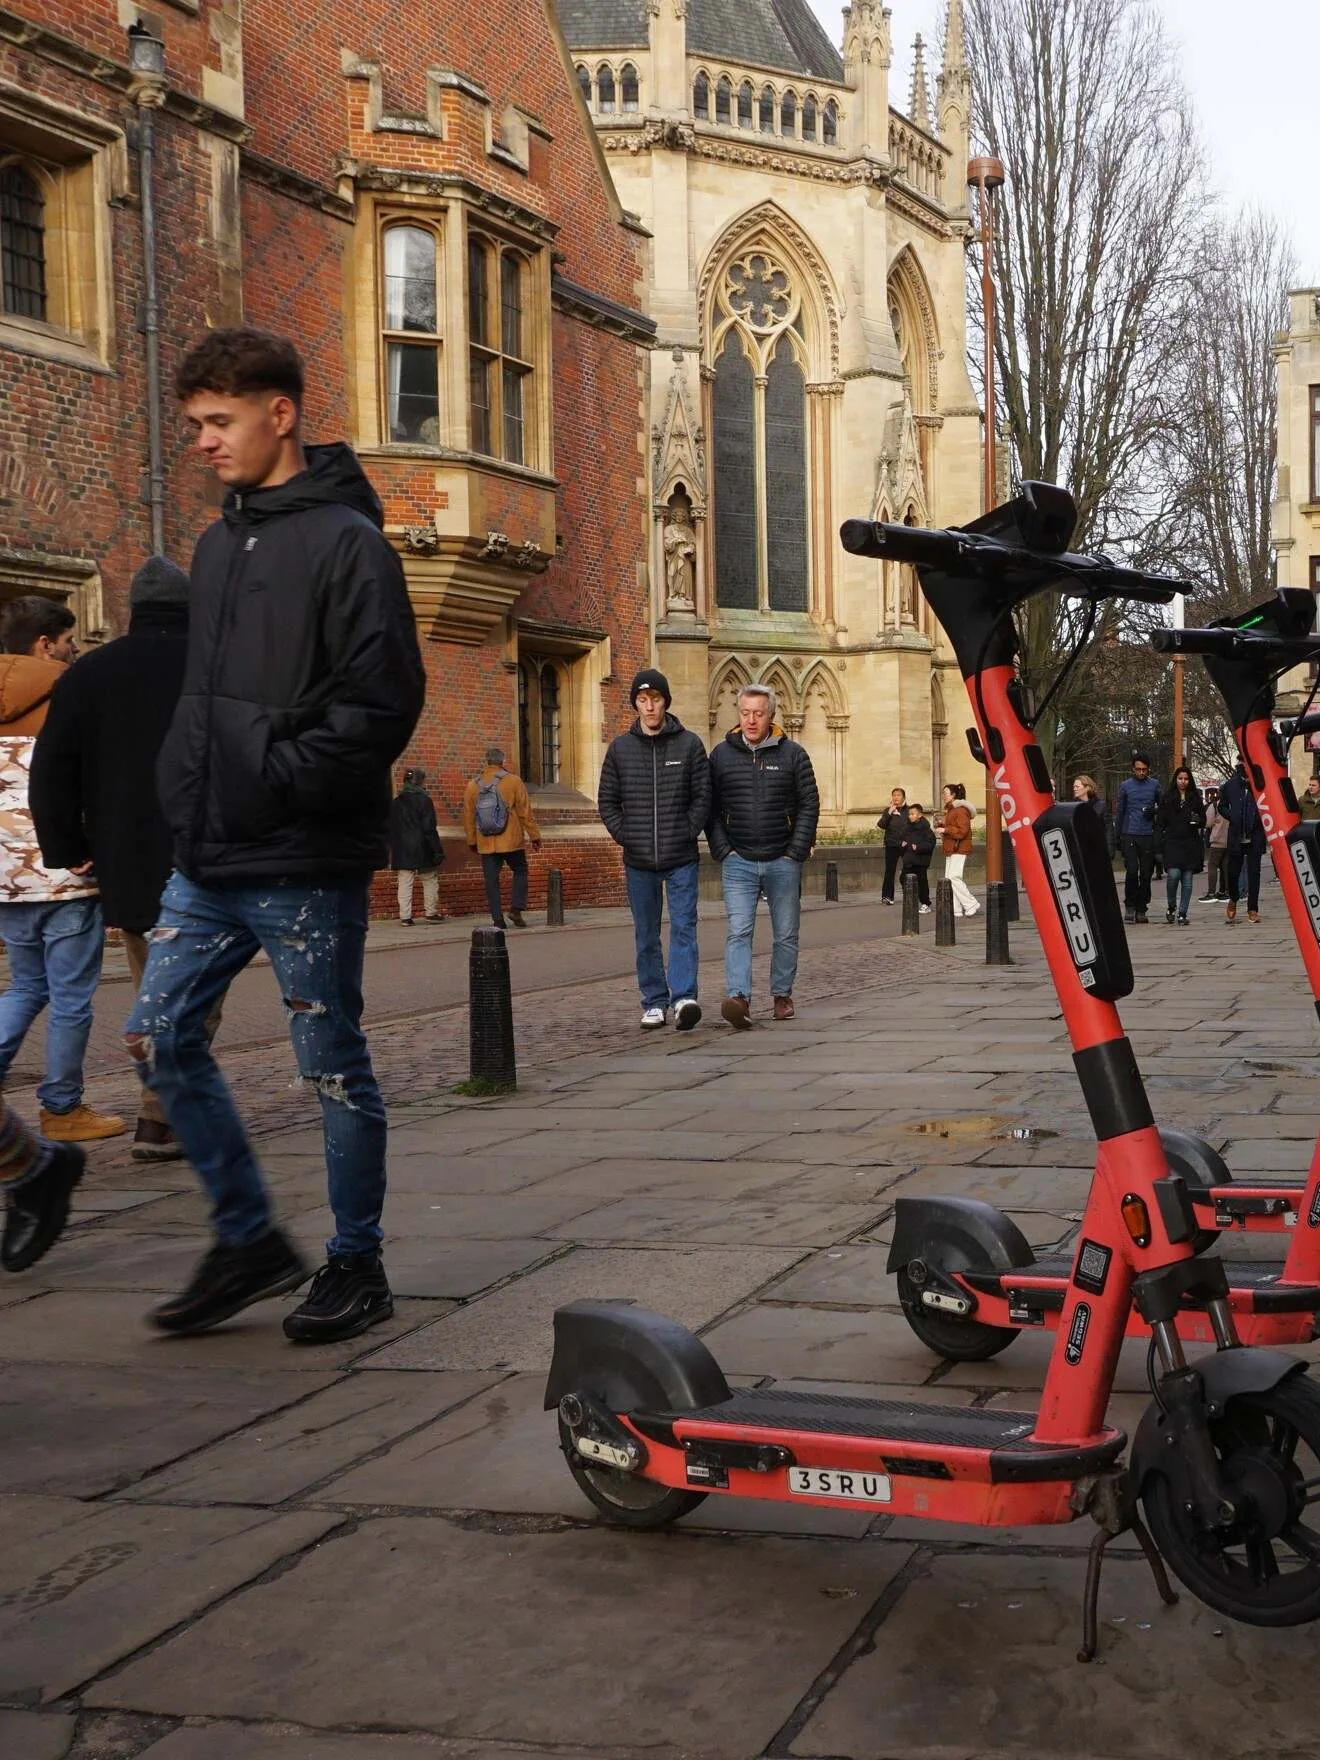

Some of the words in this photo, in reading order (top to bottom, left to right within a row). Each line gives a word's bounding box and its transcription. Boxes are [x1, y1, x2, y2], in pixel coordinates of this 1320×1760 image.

[1049, 839, 1091, 954] 3SRU
[1075, 1310, 1087, 1345] SEGWAY
[798, 1471, 878, 1497] 3SRU
